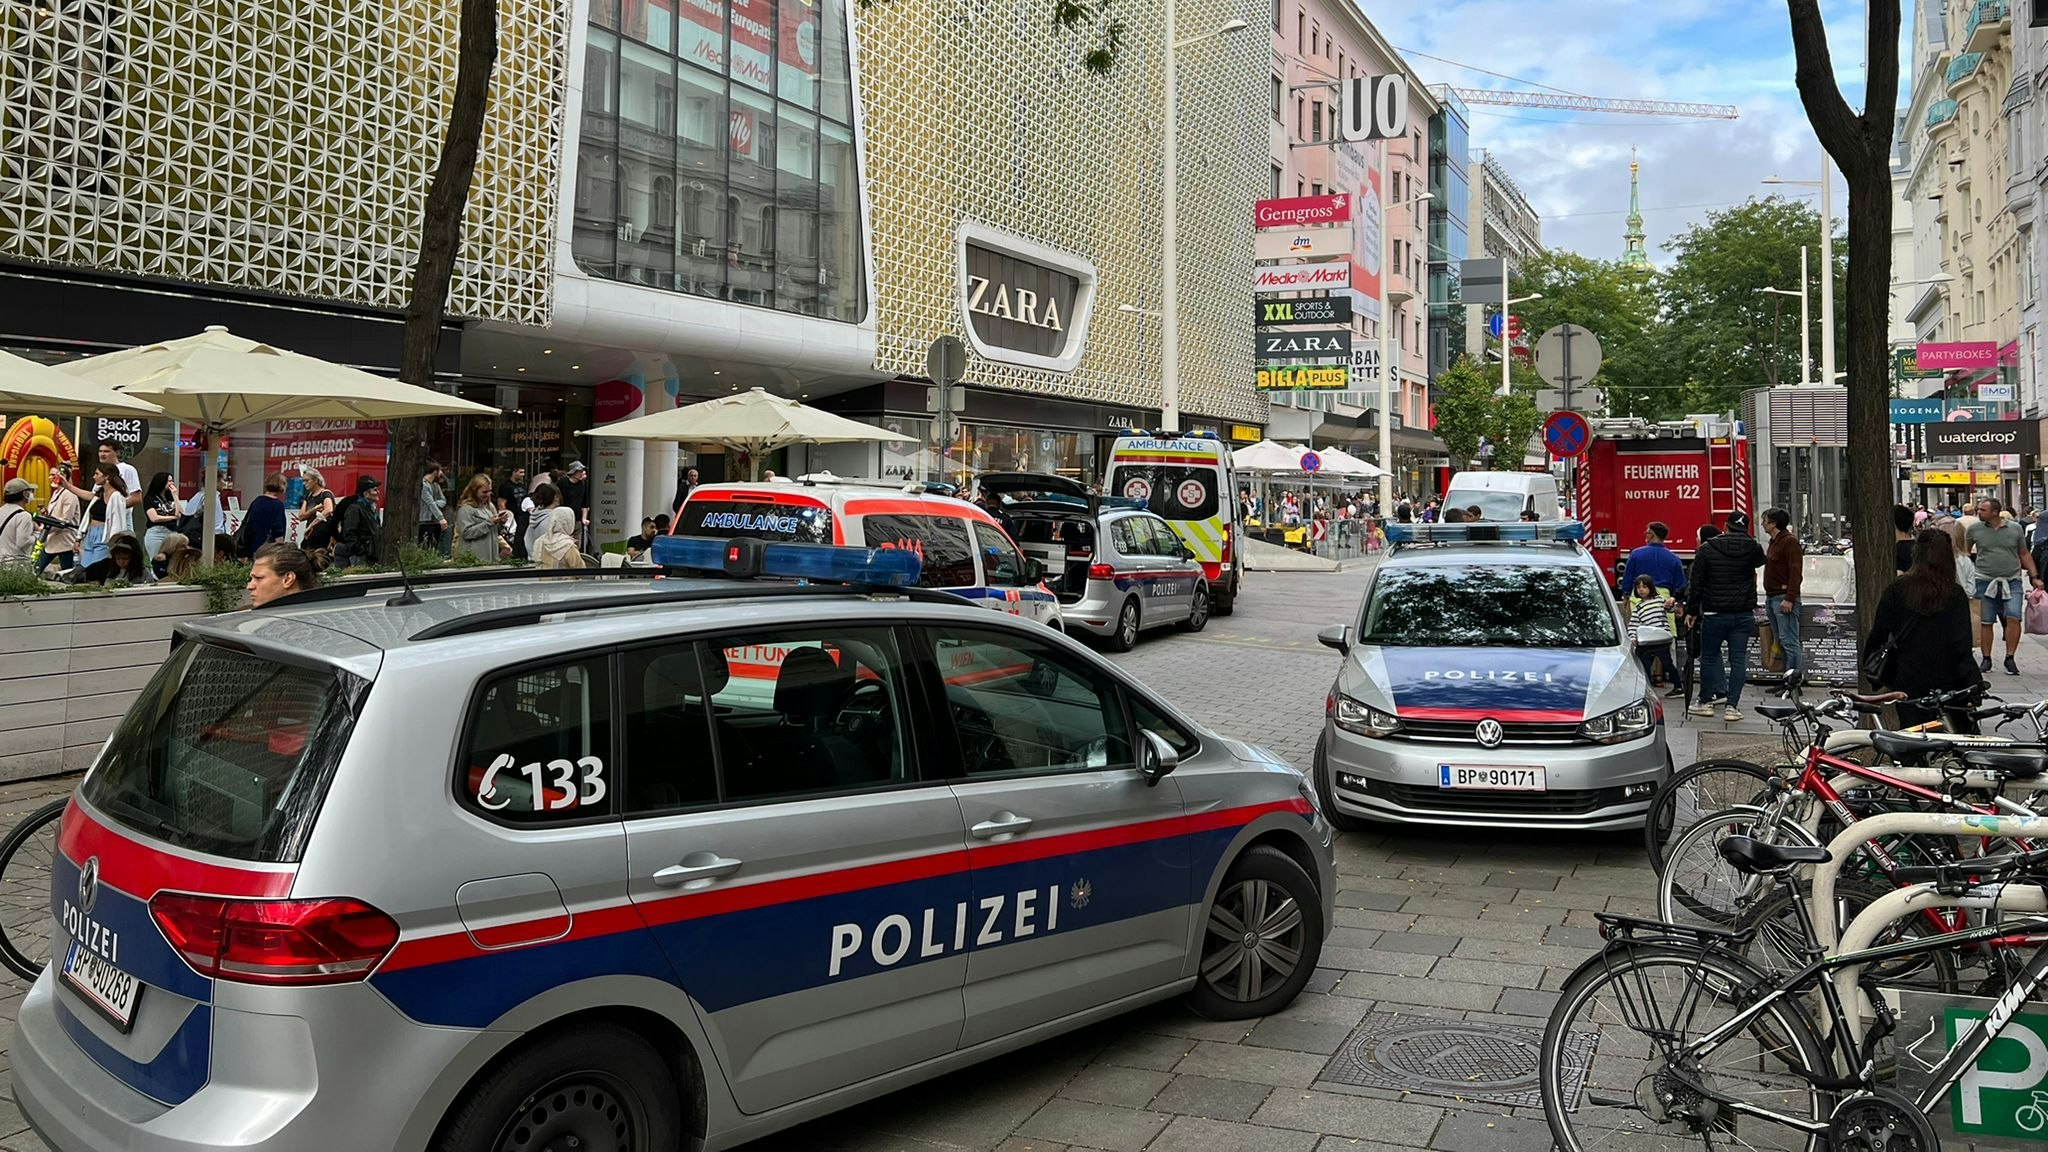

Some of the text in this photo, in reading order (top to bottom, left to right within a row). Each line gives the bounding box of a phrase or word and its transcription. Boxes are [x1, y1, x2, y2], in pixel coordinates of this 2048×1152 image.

[1342, 73, 1407, 141] UO
[1260, 207, 1333, 223] Gerngross
[1293, 236, 1310, 246] dm
[1254, 268, 1347, 285] Media Markt
[967, 275, 1063, 331] ZARA
[1264, 303, 1293, 320] XXL
[1295, 302, 1323, 310] SPORTS
[1295, 311, 1335, 319] OUTDOOR
[1266, 337, 1343, 352] ZARA
[1922, 349, 1992, 360] PARTYBOXES
[1257, 370, 1342, 387] BILLA PLUS
[1989, 387, 2011, 395] MDI
[97, 417, 141, 431] Back 2
[1109, 415, 1134, 428] ZARA
[97, 429, 140, 443] School
[1939, 431, 2016, 444] waterdrop
[270, 438, 355, 457] im GERNGROSS
[1128, 440, 1204, 451] AMBULANCE
[281, 454, 346, 473] präsentiert:
[885, 465, 914, 476] ZARA
[1624, 465, 1699, 479] FEUERWEHR
[1188, 489, 1195, 498] S
[1625, 485, 1700, 499] NOTRUF 122
[701, 512, 799, 533] AMBULANCE
[1151, 583, 1177, 597] POLIZEI
[1424, 670, 1552, 682] POLIZEI
[521, 755, 606, 811] 133
[1458, 769, 1477, 784] BP
[1490, 770, 1535, 786] 90171
[63, 899, 118, 963] POLIZEI
[828, 885, 1060, 977] POLIZEI
[1970, 928, 1998, 939] AVENZA
[92, 959, 132, 1010] 90268
[1985, 982, 2027, 1039] KTM
[1955, 1018, 2048, 1125] P
